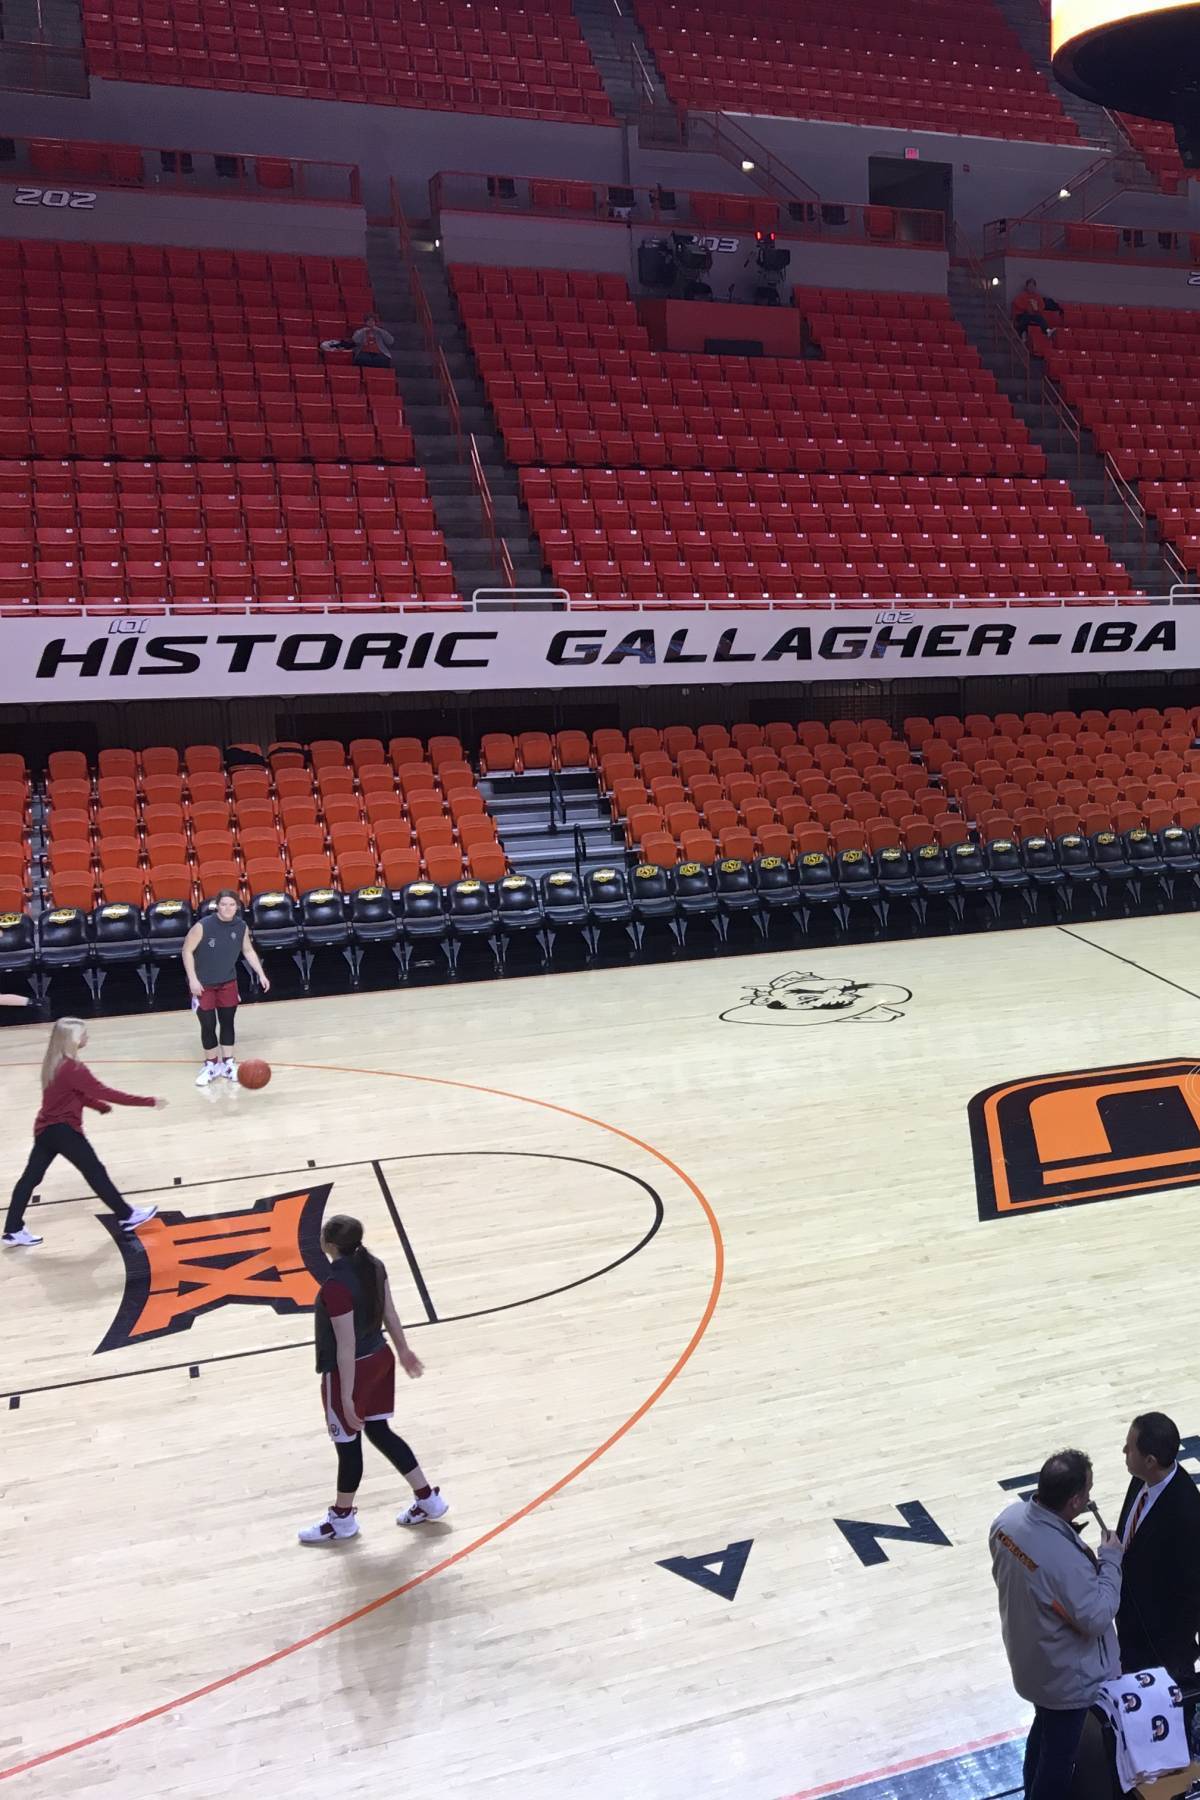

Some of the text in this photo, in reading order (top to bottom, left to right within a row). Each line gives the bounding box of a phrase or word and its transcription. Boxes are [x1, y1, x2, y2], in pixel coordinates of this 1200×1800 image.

[14, 187, 97, 209] 202
[691, 236, 739, 253] 03
[108, 618, 150, 634] 101
[875, 611, 914, 624] 102
[36, 634, 498, 679] HISTORIC
